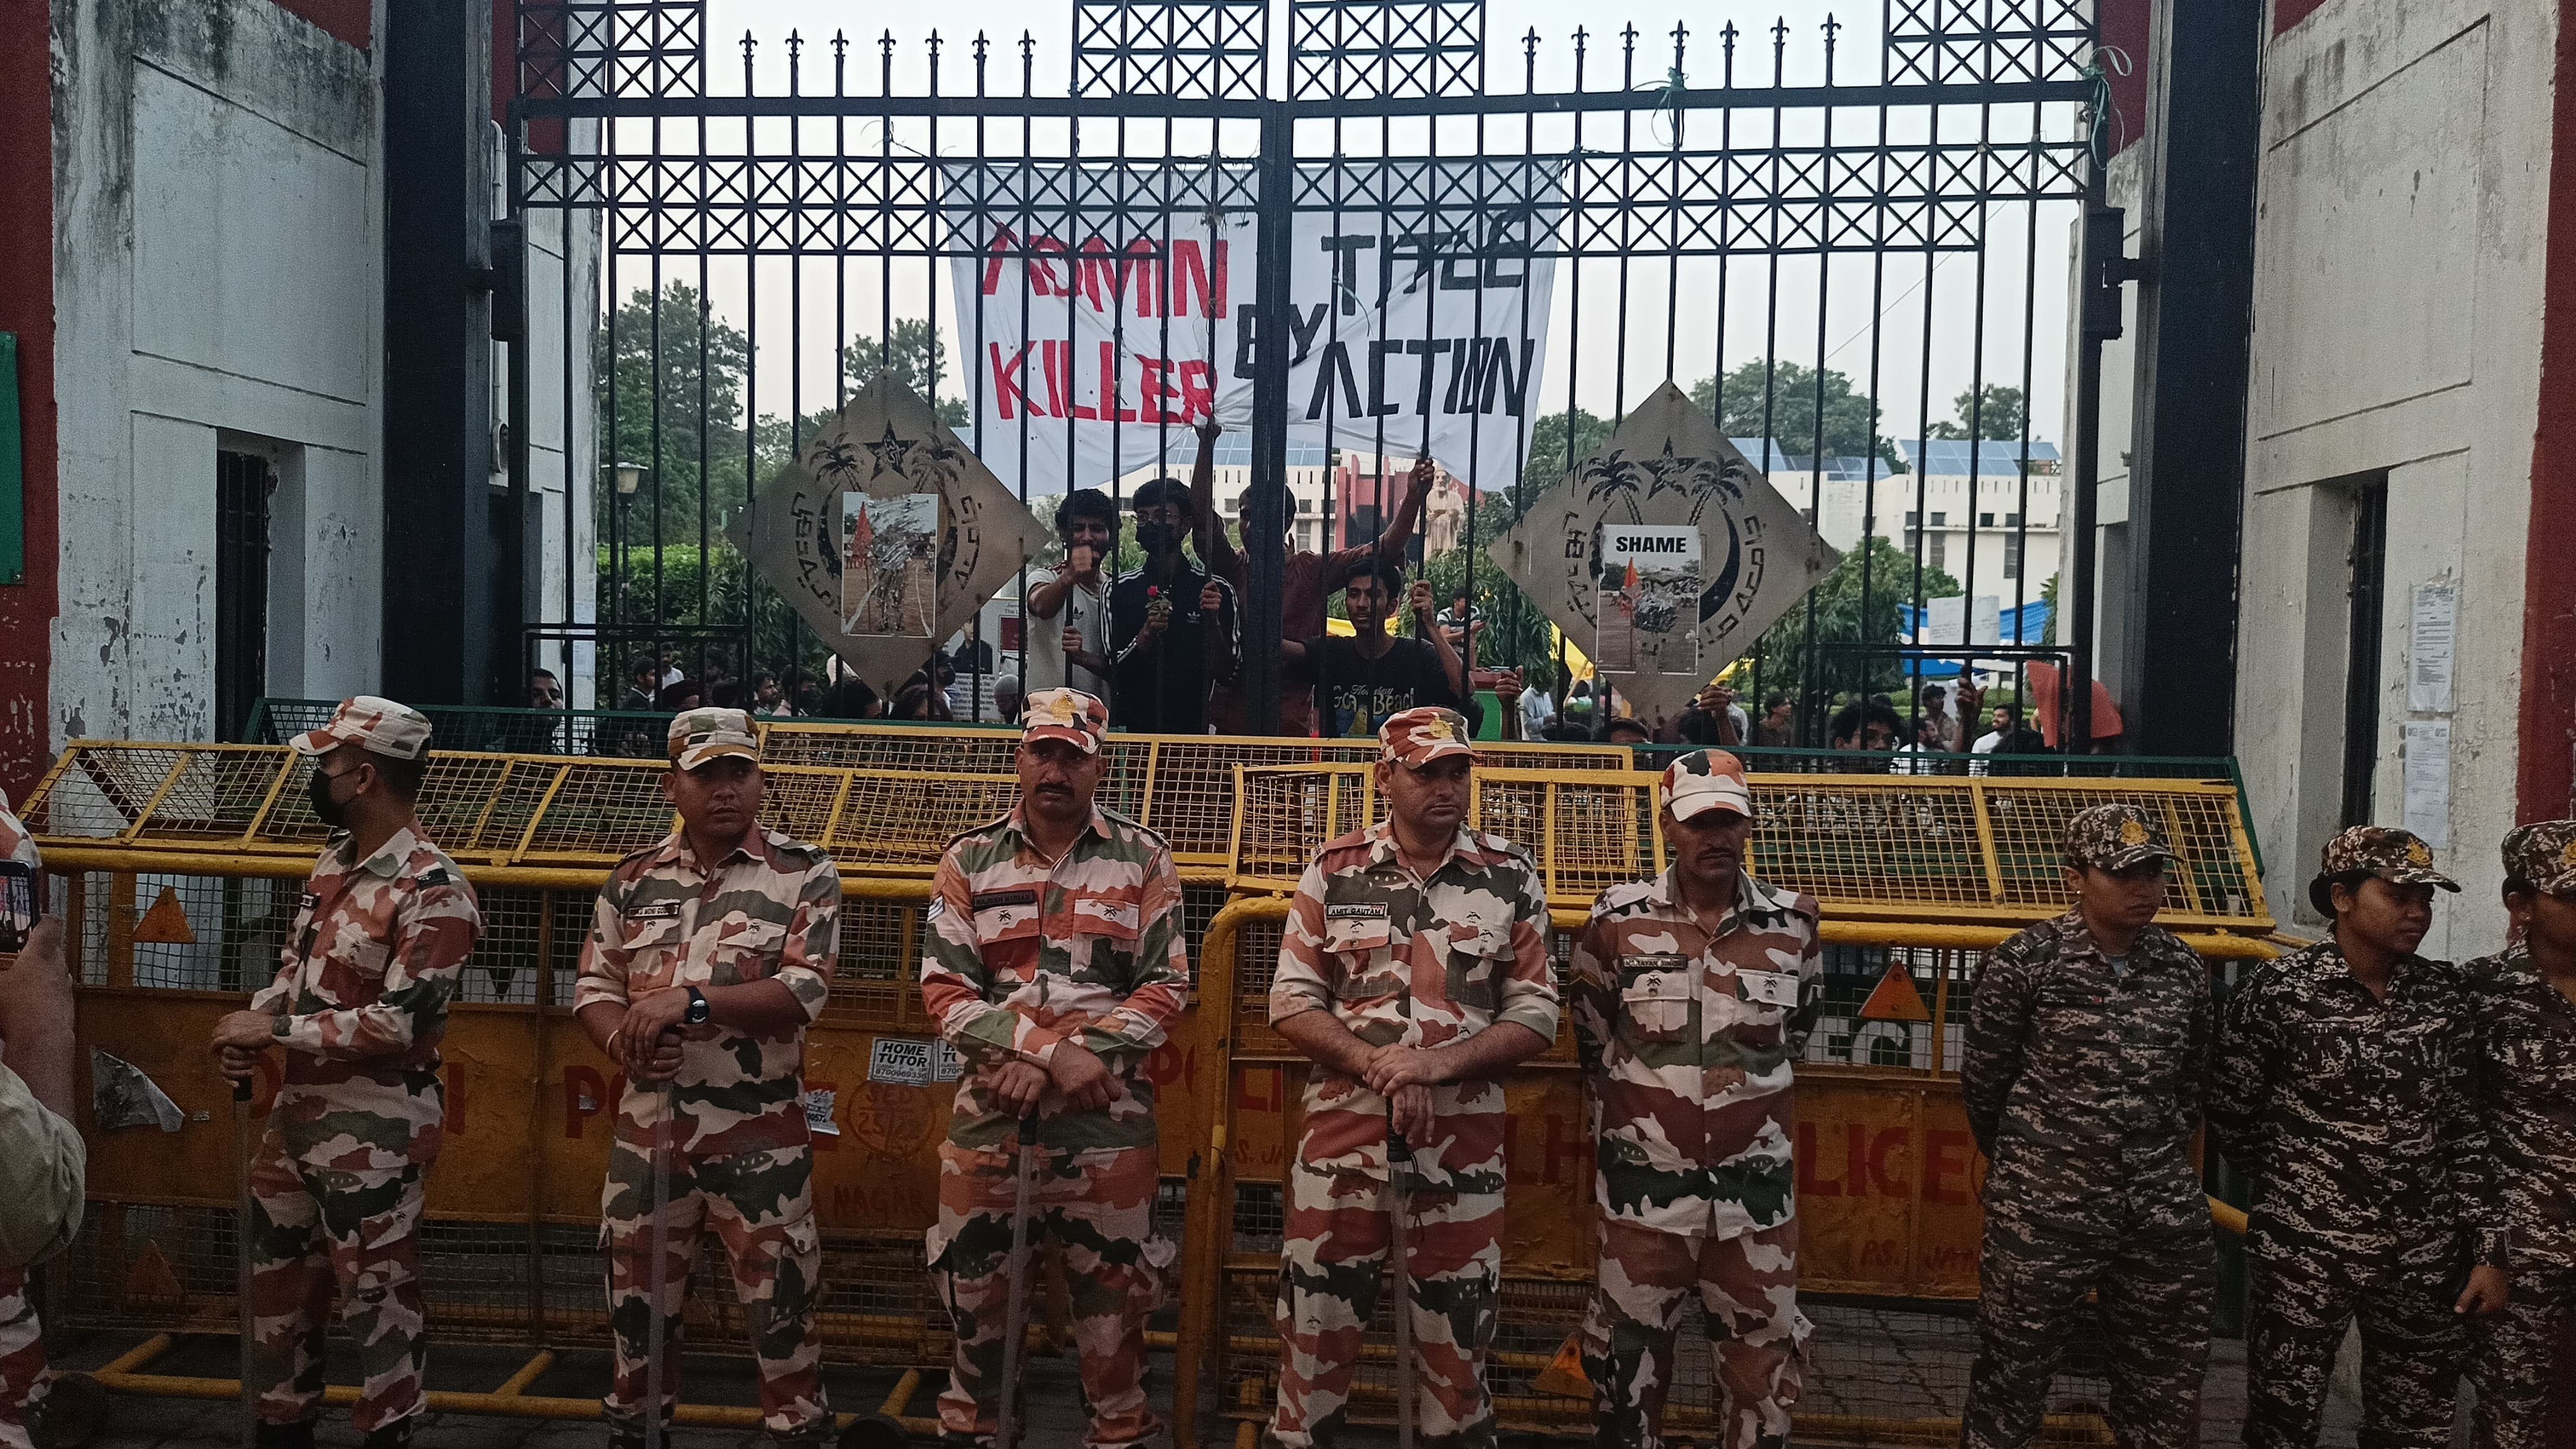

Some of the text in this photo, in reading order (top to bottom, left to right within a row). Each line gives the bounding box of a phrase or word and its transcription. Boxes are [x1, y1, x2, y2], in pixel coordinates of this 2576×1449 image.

[983, 223, 1228, 318] ADMIN
[990, 339, 1219, 425] KILLER
[1306, 337, 1534, 419] ACTION
[1616, 536, 1687, 554] SHAME
[876, 1068, 927, 1079] 8700969336
[879, 1053, 928, 1067] TUTOR
[882, 1043, 926, 1056] HOME
[1798, 1121, 1968, 1204] LICE
